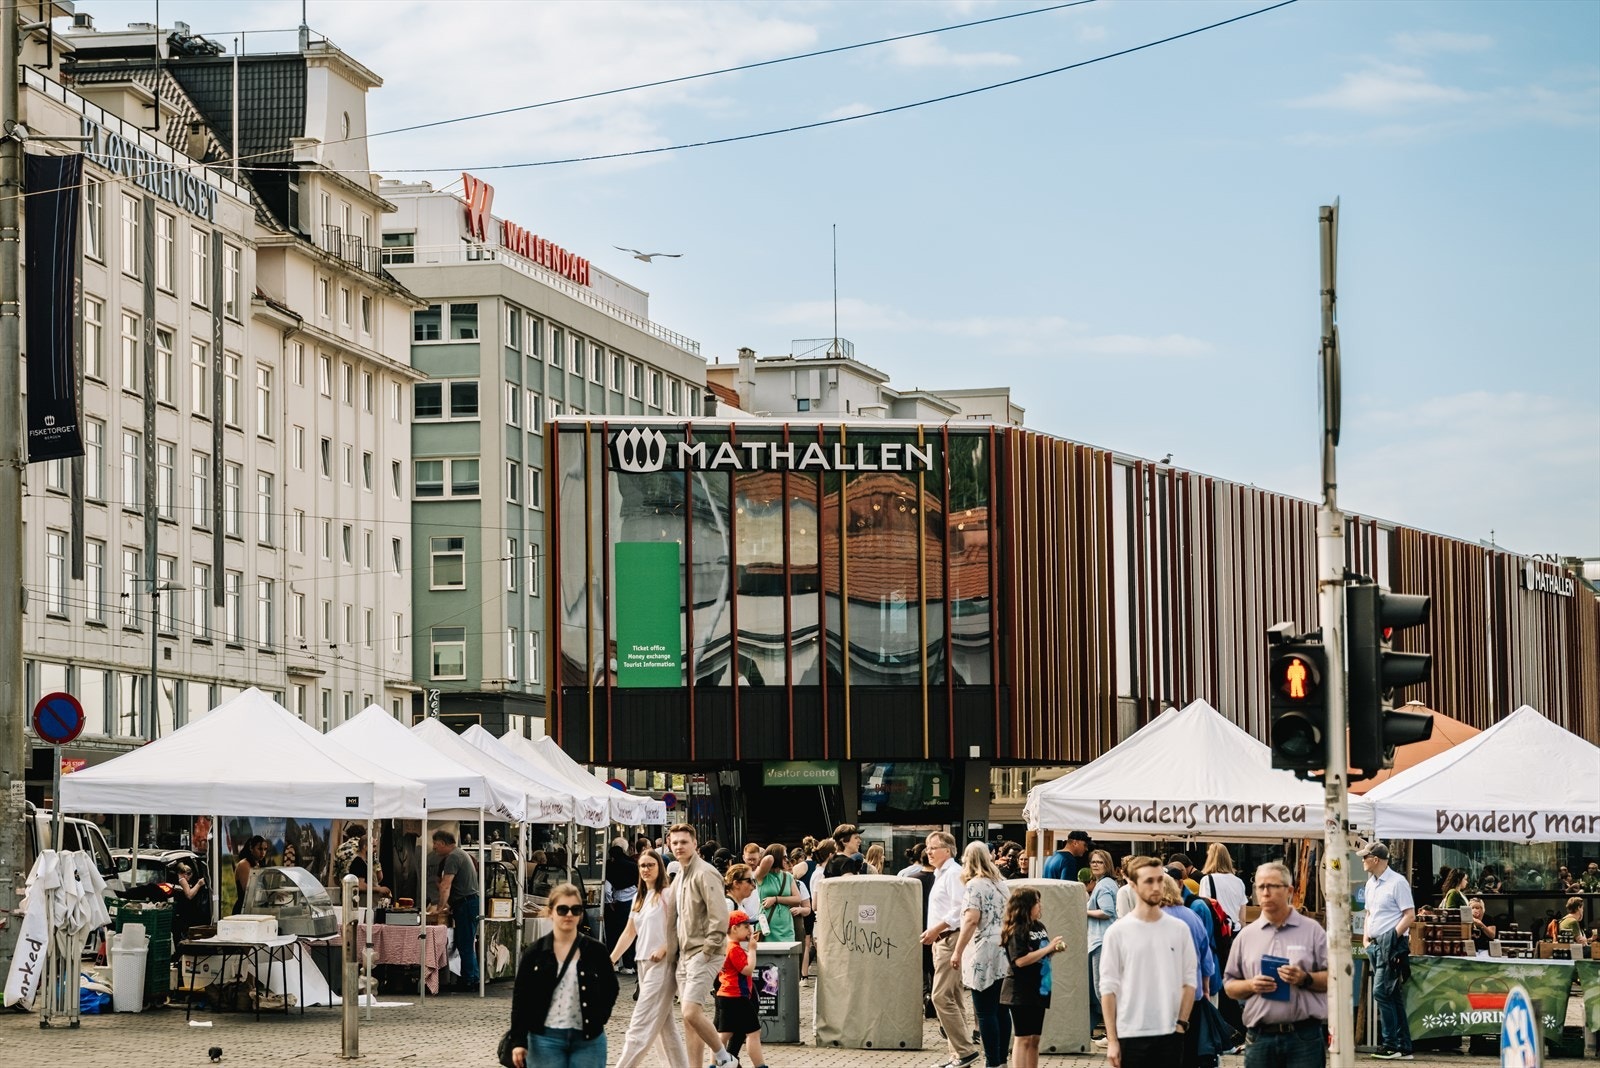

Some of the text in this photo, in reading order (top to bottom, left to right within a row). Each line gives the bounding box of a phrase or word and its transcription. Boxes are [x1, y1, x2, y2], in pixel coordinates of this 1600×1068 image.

[82, 117, 219, 224] KLØVERHUSET
[504, 220, 592, 287] WALLENDAHL
[30, 424, 76, 437] FISKETORGET
[678, 441, 933, 471] MATHALLEN
[1535, 571, 1575, 598] MATHALLEN
[428, 688, 440, 719] Res
[767, 768, 836, 778] Visitor centre
[1098, 799, 1306, 829] Bondens marked
[1436, 810, 1538, 839] Bondens
[19, 938, 43, 999] arked
